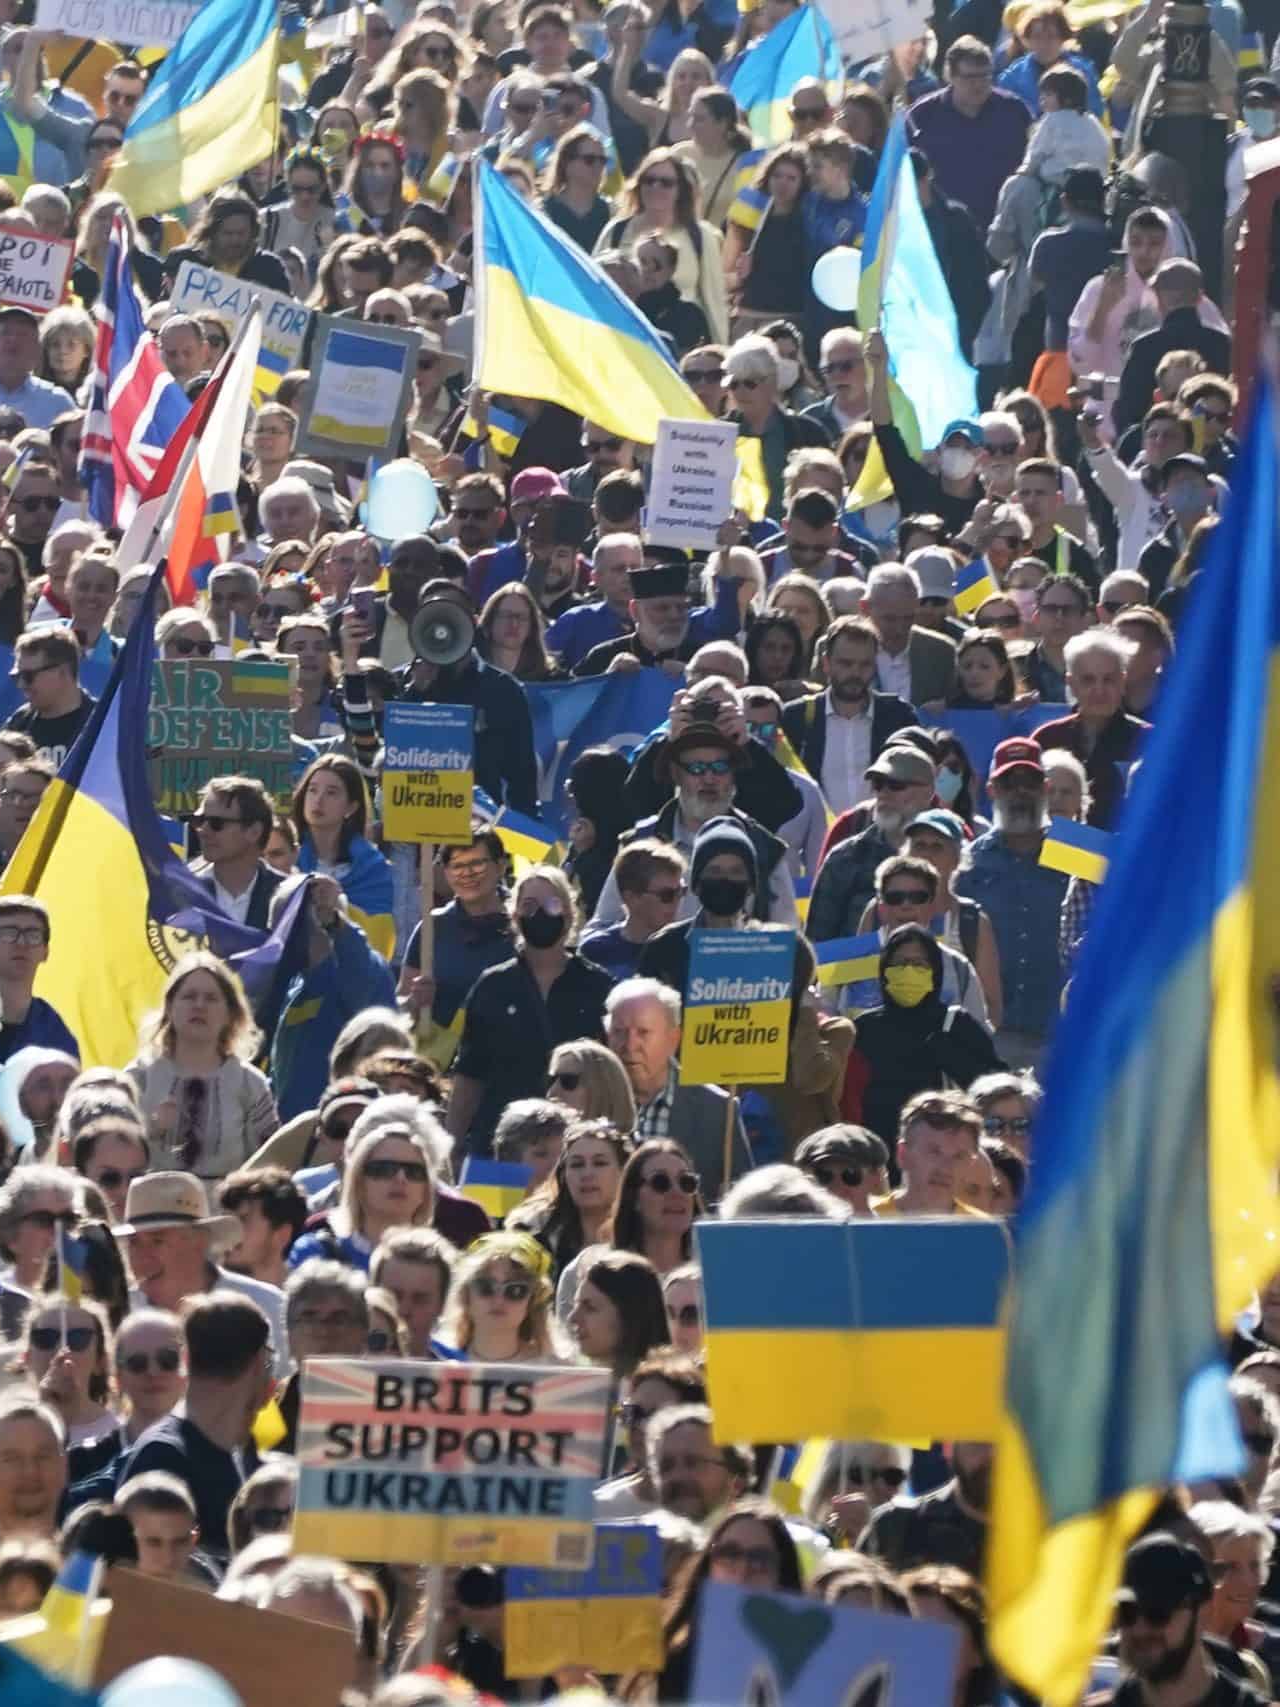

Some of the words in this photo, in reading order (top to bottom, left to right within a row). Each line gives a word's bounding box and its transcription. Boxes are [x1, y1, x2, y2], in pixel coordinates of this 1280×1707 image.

[266, 301, 308, 336] FOR
[670, 430, 725, 446] Solidarity
[671, 464, 716, 478] Ukraine
[668, 498, 714, 512] Russian
[147, 706, 294, 752] DEFENSE
[386, 746, 472, 771] Solidarity
[406, 771, 440, 785] with
[392, 785, 465, 809] Ukraine
[689, 976, 791, 1002] Solidarity
[713, 1003, 752, 1021] with
[695, 1021, 780, 1045] Ukraine
[375, 1374, 535, 1417] BRITS
[324, 1423, 575, 1467] SUPPORT
[325, 1471, 568, 1515] UKRAINE
